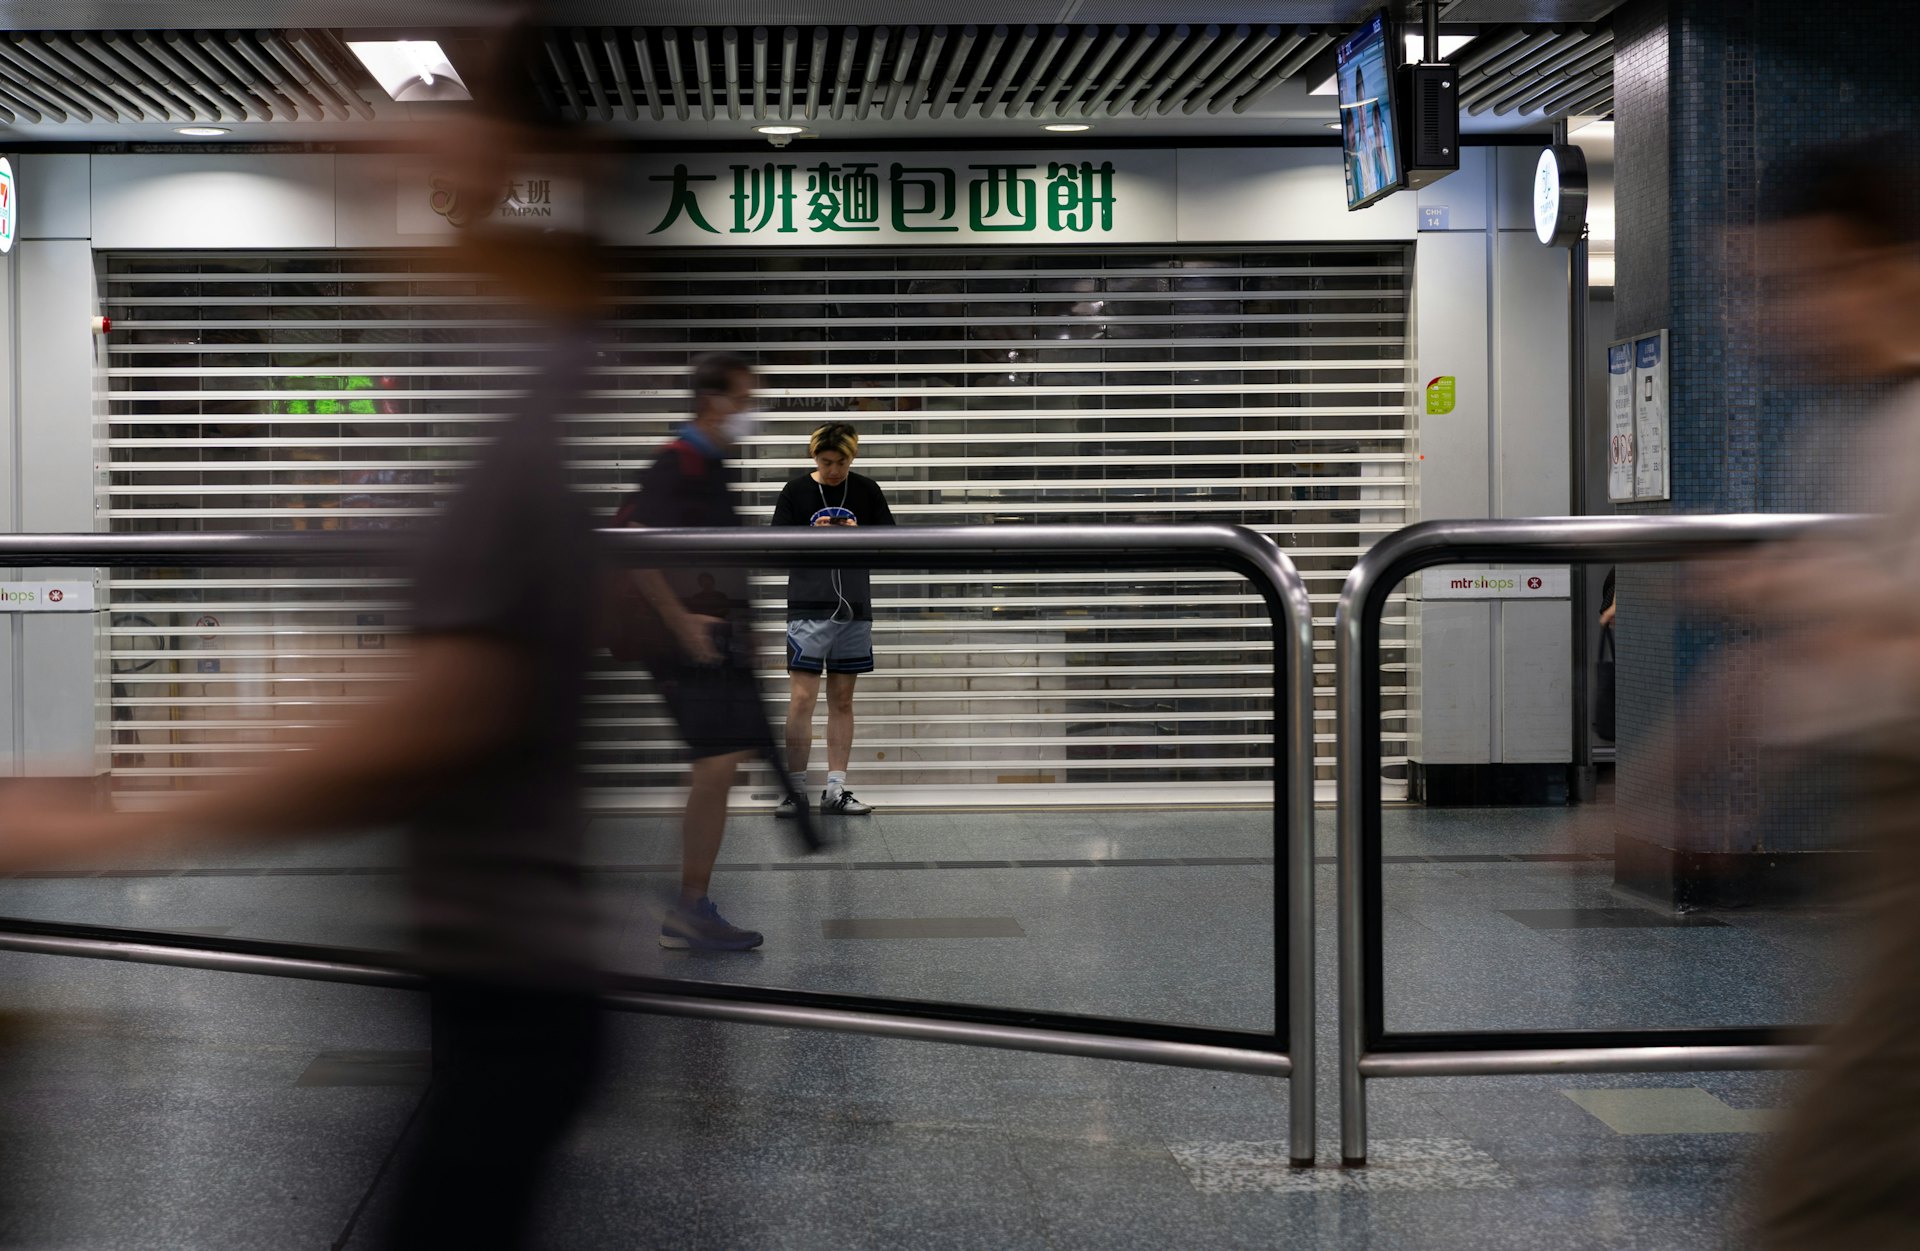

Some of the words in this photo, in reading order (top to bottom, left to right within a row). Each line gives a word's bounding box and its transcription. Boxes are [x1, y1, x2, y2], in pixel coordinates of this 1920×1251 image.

[499, 179, 551, 205] 大班
[647, 161, 1116, 234] 大班麵包西餅
[499, 207, 551, 217] TAIPAN
[1425, 208, 1442, 216] CHH
[1428, 218, 1440, 227] 14
